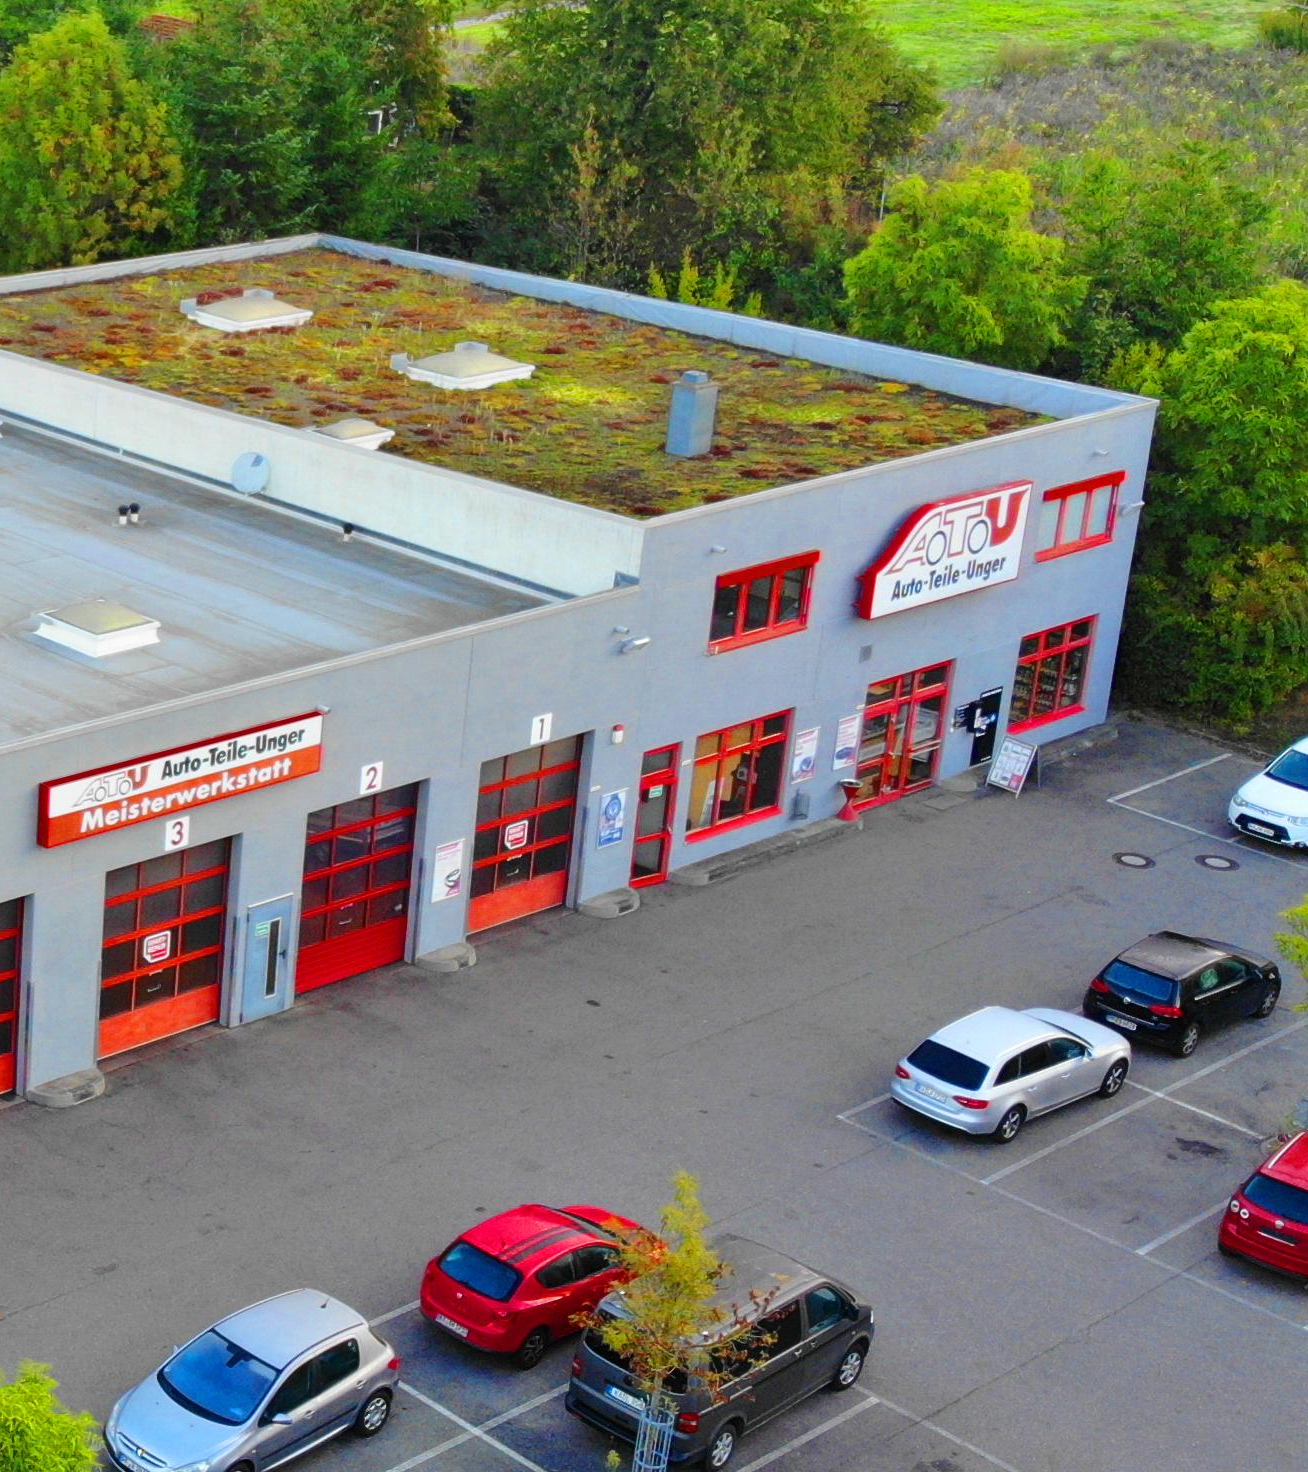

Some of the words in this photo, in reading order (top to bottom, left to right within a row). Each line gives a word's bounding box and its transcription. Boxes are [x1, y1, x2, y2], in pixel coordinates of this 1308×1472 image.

[891, 556, 1007, 602] Auto-Teile-Unger
[538, 717, 545, 740] 1
[161, 726, 306, 781] Auto-Teile-Unger
[79, 756, 293, 834] Meisterwerkstatt
[365, 766, 378, 791] 2
[171, 820, 184, 846] 3
